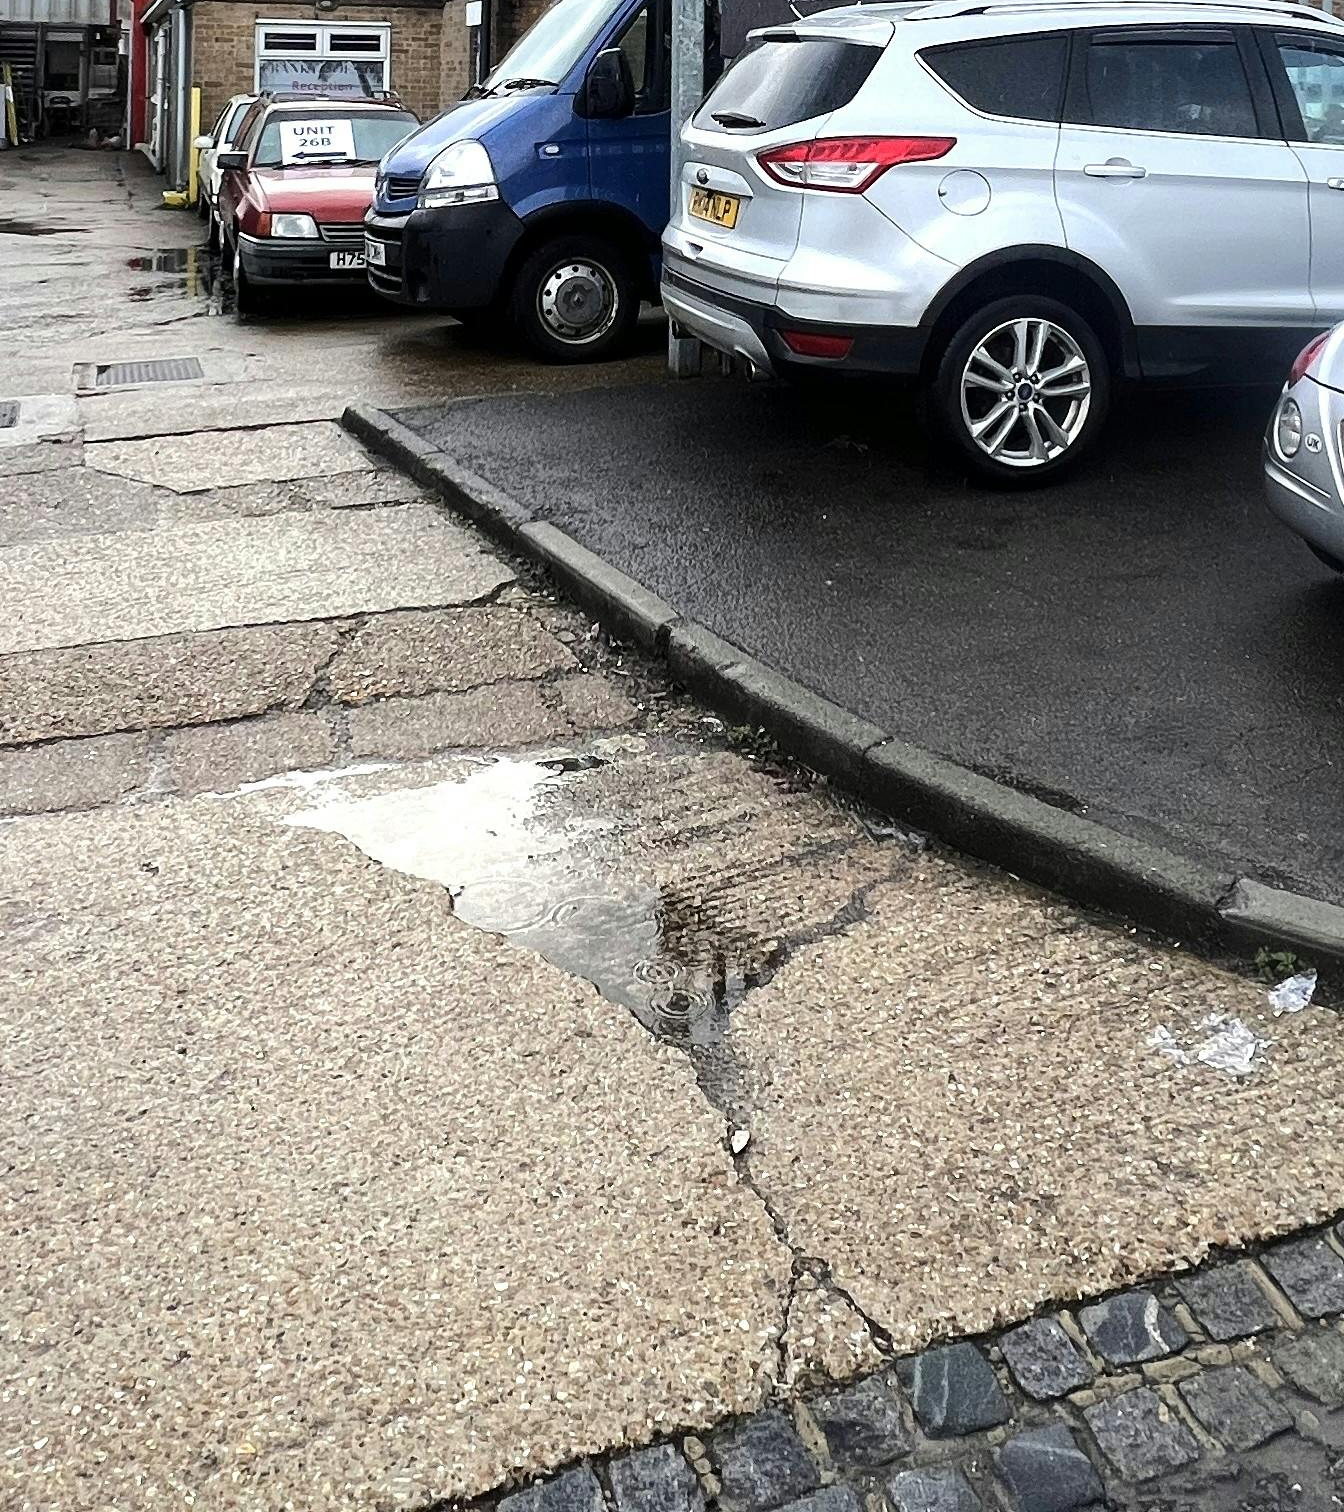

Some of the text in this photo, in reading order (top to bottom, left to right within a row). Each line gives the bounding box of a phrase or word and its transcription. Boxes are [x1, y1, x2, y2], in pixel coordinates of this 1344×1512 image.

[292, 80, 353, 92] Reception
[293, 126, 335, 136] UNIT
[299, 138, 331, 147] 26B
[1306, 435, 1320, 450] UK
